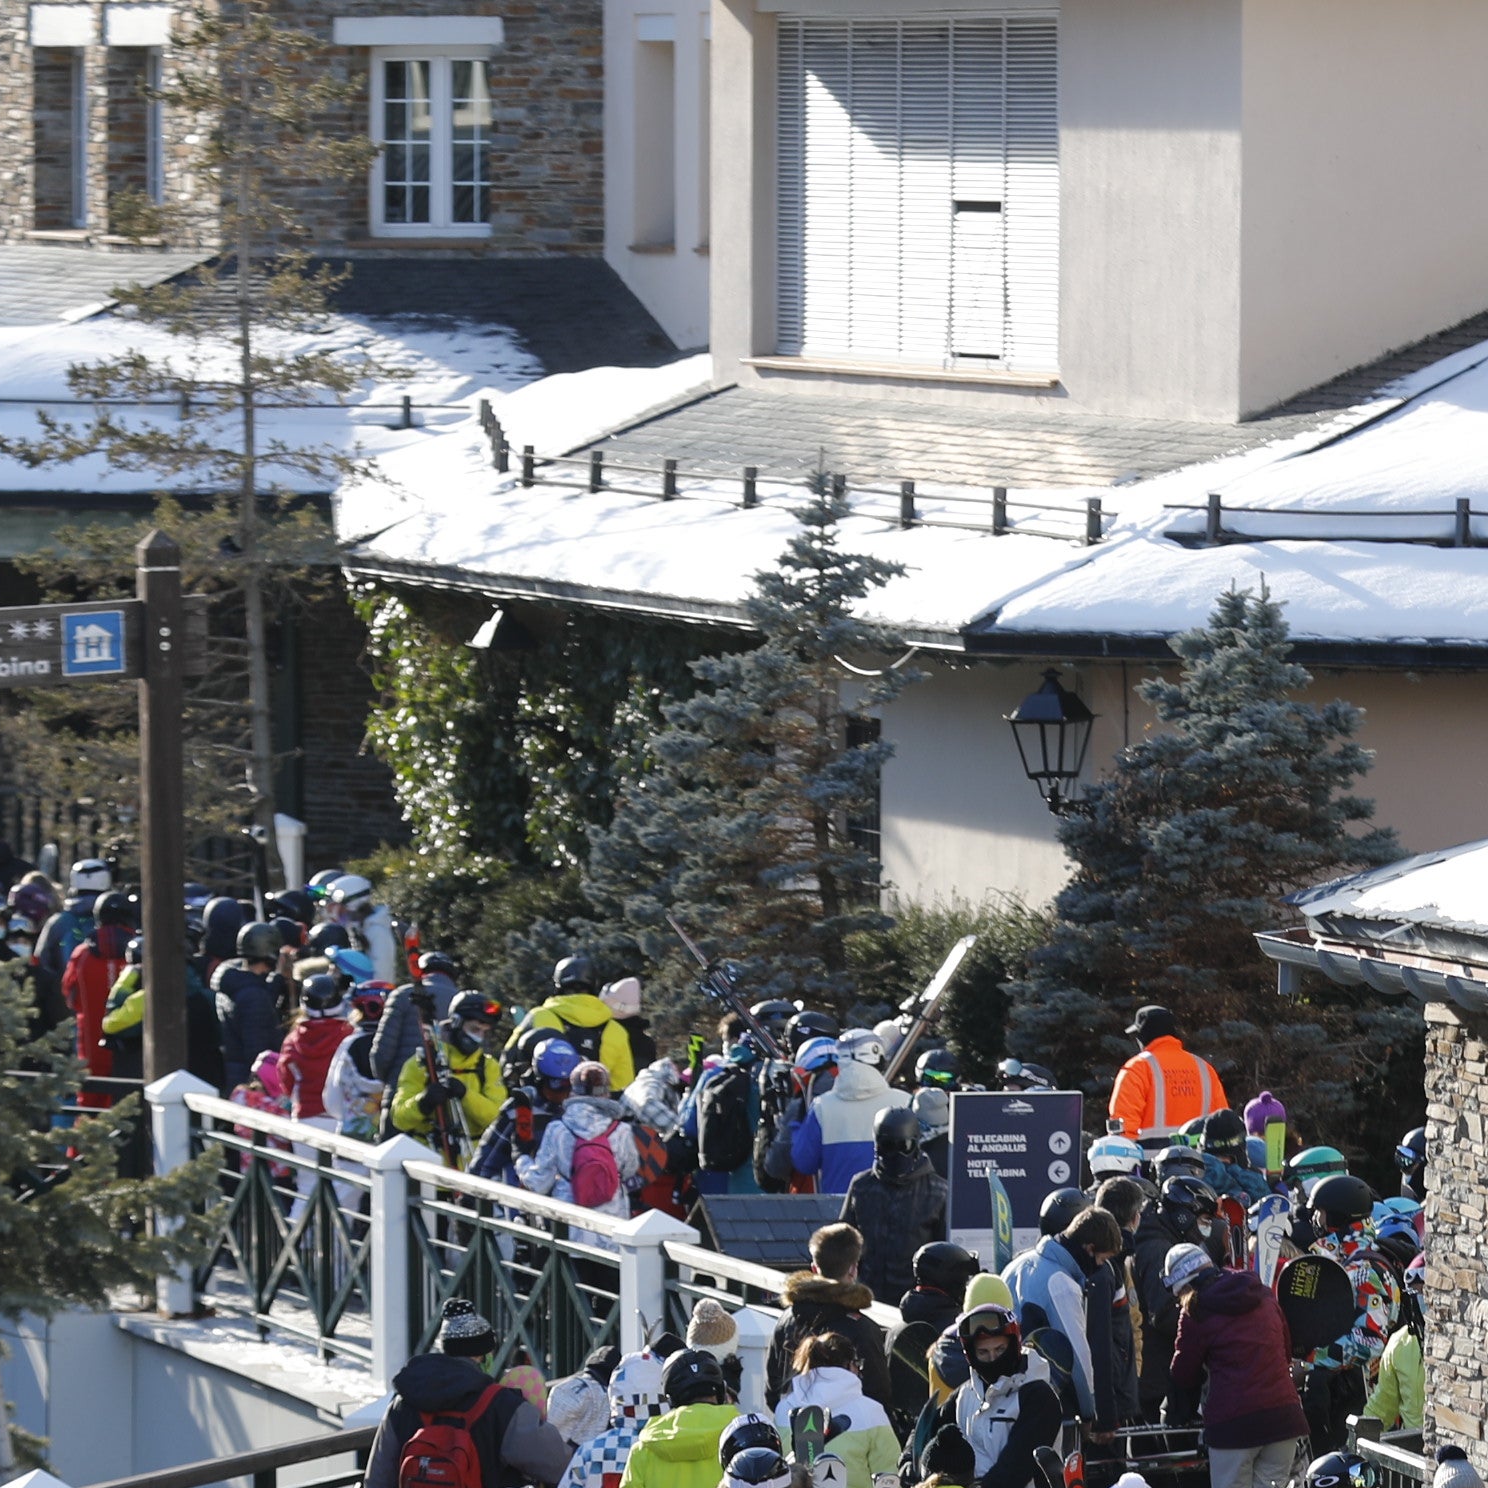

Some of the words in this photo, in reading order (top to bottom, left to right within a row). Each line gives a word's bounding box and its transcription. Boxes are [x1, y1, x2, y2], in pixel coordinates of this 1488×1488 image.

[967, 1134, 1027, 1144] TELECABINA
[967, 1144, 981, 1153] AL
[981, 1144, 1027, 1153] ANDALUS
[967, 1159, 999, 1168] HOTEL
[967, 1168, 1026, 1178] TELABINA
